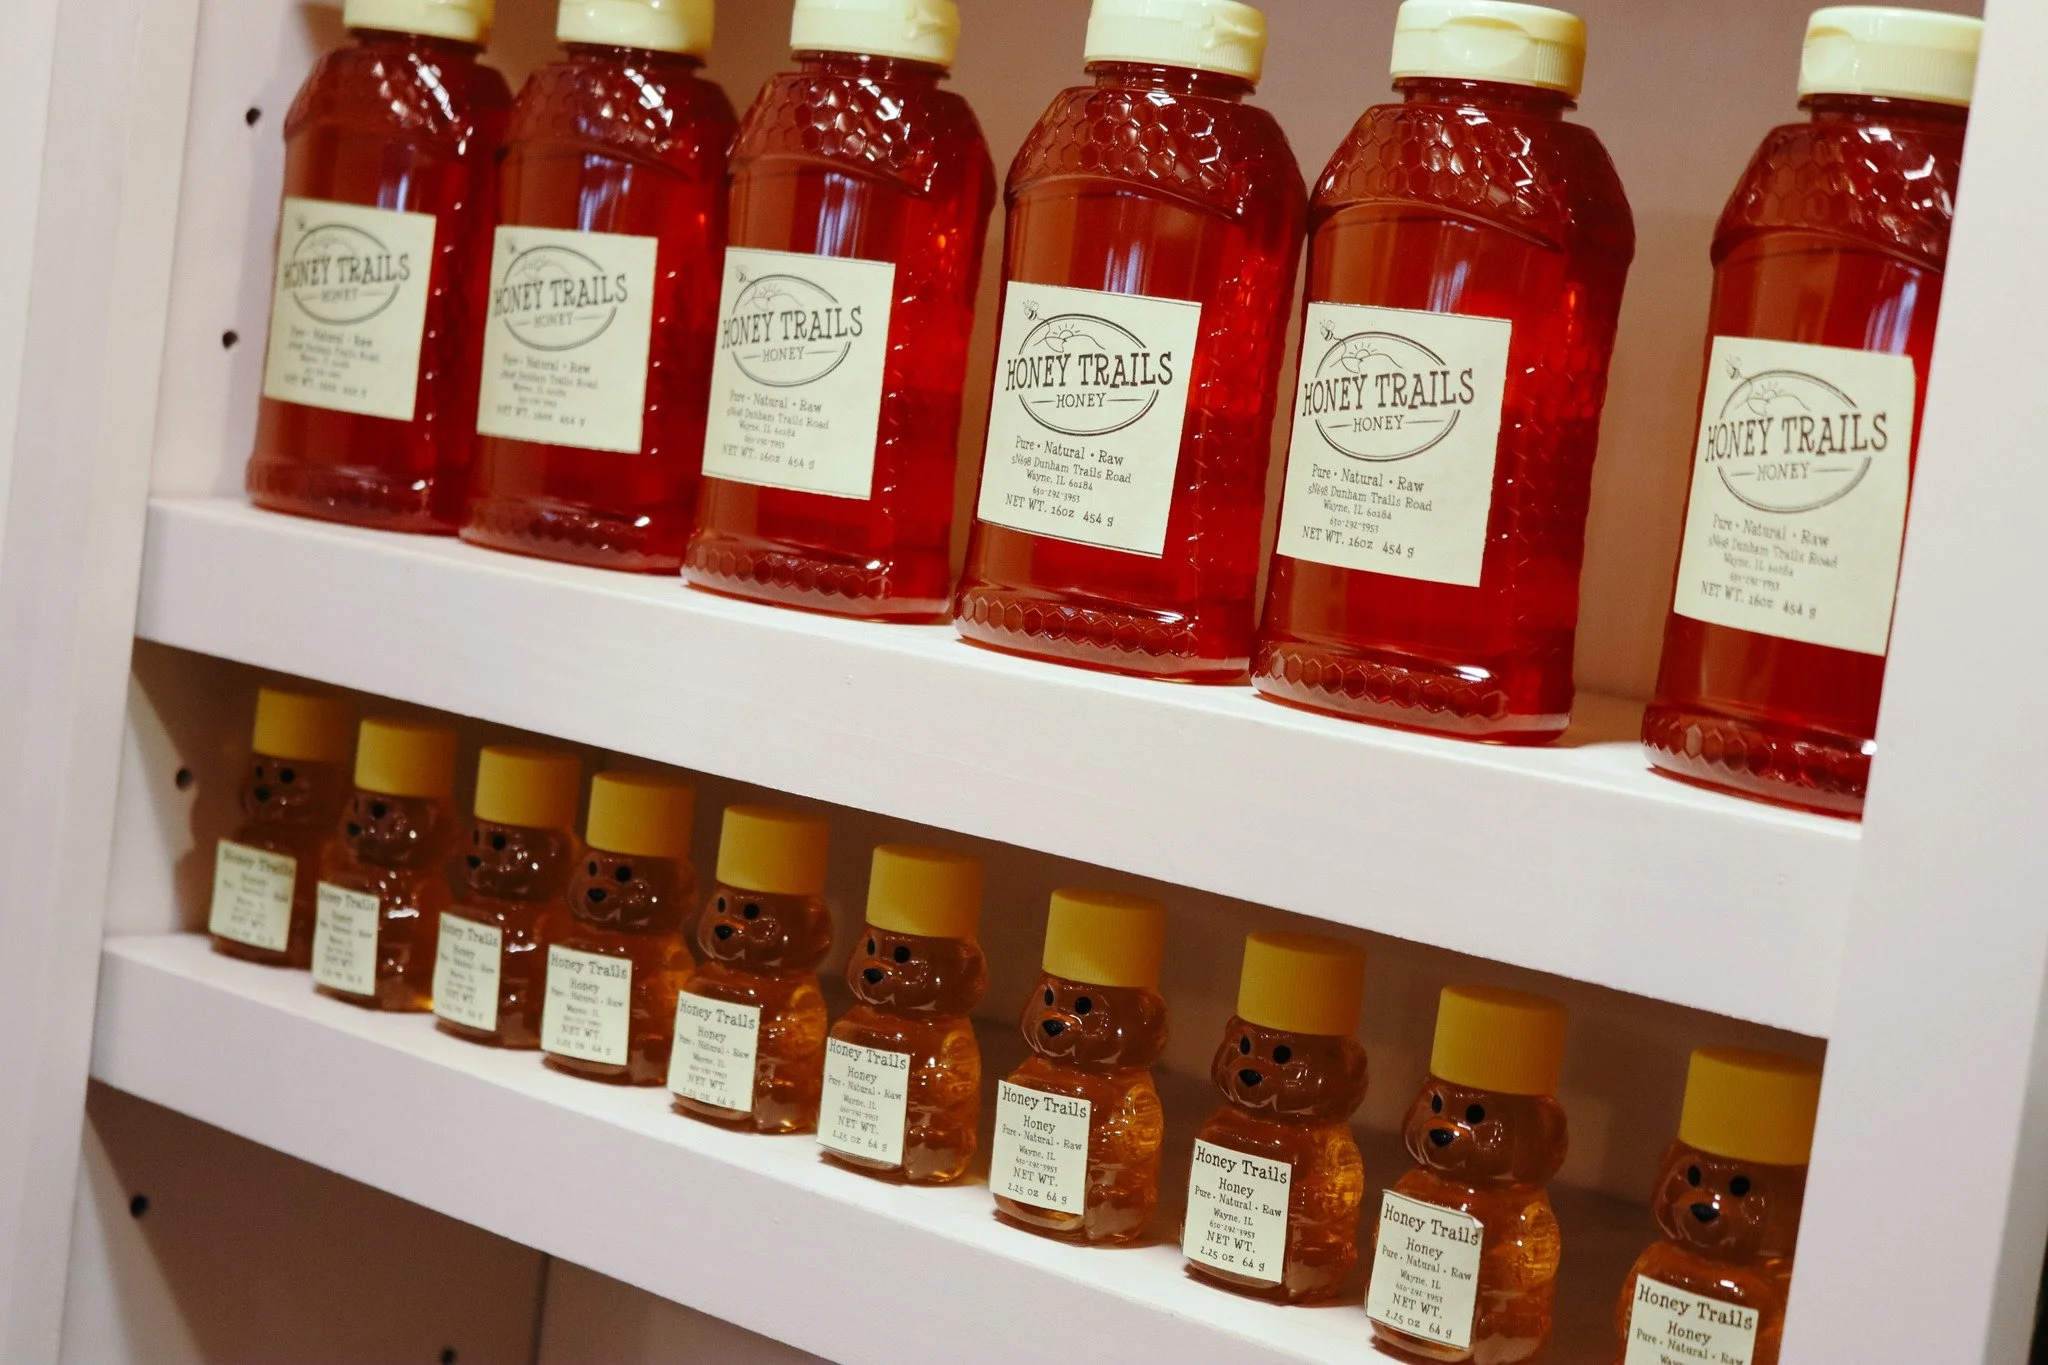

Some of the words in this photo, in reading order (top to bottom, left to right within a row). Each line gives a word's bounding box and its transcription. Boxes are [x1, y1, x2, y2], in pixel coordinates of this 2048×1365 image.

[284, 256, 331, 288] HONEY
[338, 253, 411, 285] TRAILS
[494, 280, 543, 316] HONEY
[551, 274, 628, 308] TRAILS
[534, 312, 574, 328] HONEY
[722, 311, 774, 349] HONEY
[781, 306, 862, 341] TRAILS
[763, 346, 805, 362] HONEY
[1005, 353, 1071, 391] HONEY
[1078, 351, 1173, 388] TRAILS
[730, 389, 745, 402] Pure
[754, 393, 787, 408] Natural
[800, 399, 822, 412] Raw
[1056, 393, 1106, 408] HONEY
[1302, 374, 1368, 417] HONEY
[1375, 368, 1475, 410] TRAILS
[745, 408, 774, 422] Dunham
[778, 413, 802, 426] Trails
[807, 418, 829, 429] Road
[1353, 414, 1404, 433] HONEY
[1705, 416, 1774, 463] HONEY
[1782, 412, 1888, 457] TRAILS
[722, 444, 738, 456] NET
[788, 456, 804, 468] 454
[809, 460, 815, 470] g
[1016, 435, 1034, 450] Pure
[1044, 441, 1085, 459] Natural
[1098, 450, 1124, 466] Raw
[1027, 469, 1053, 484] Wayne,
[1056, 475, 1065, 485] IL
[1069, 478, 1093, 491] 60184
[1034, 457, 1069, 473] Dunham
[1073, 463, 1102, 478] Trails
[1106, 470, 1132, 484] Road
[1312, 463, 1331, 479] Pure
[1341, 468, 1383, 487] Natural
[1397, 476, 1425, 492] Raw
[1757, 462, 1809, 481] HONEY
[1005, 493, 1025, 507] NET
[1029, 498, 1047, 513] WT.
[1051, 505, 1075, 518] 16oz
[1083, 511, 1102, 524] 454
[1107, 516, 1114, 527] g
[1324, 499, 1350, 514] Wayne,
[1354, 505, 1363, 515] IL
[1366, 508, 1392, 520] 60184
[1331, 486, 1366, 502] Dunham
[1371, 492, 1401, 507] Trails
[1406, 497, 1433, 511] Road
[1302, 526, 1322, 540] NET
[1326, 529, 1344, 545] WT.
[1349, 536, 1374, 549] 16oz
[1382, 541, 1401, 555] 454
[1407, 546, 1415, 558] g
[1713, 512, 1732, 531] Pure
[1743, 518, 1786, 540] Natural
[1801, 529, 1829, 547] Raw
[1774, 546, 1804, 563] Trails
[1809, 551, 1838, 568] Road
[1701, 581, 1721, 597] NET
[1725, 585, 1744, 603] WT.
[1783, 601, 1803, 616] 454
[1809, 607, 1817, 620] g
[551, 953, 583, 973] Honey
[589, 961, 627, 979] Trails
[571, 978, 599, 993] Honey
[680, 999, 712, 1021] Honey
[716, 1009, 755, 1029] Trails
[697, 1026, 726, 1043] Honey
[698, 1040, 725, 1054] Natural
[733, 1048, 749, 1059] Raw
[829, 1041, 862, 1061] Honey
[867, 1049, 907, 1070] Trails
[688, 1074, 706, 1086] NET
[710, 1080, 728, 1092] WT.
[828, 1075, 841, 1086] Pure
[848, 1081, 876, 1095] Natural
[884, 1089, 902, 1100] Raw
[847, 1066, 878, 1084] Honey
[869, 1101, 877, 1109] IL
[1003, 1086, 1039, 1110] Honey
[1044, 1097, 1086, 1118] Trails
[838, 1116, 857, 1129] NET
[861, 1122, 879, 1135] WT.
[1003, 1124, 1016, 1136] Pure
[1024, 1131, 1054, 1145] Natural
[1064, 1139, 1082, 1150] Raw
[1023, 1115, 1056, 1134] Honey
[851, 1136, 861, 1144] oz
[868, 1139, 878, 1149] 64
[882, 1144, 888, 1152] g
[1019, 1145, 1043, 1159] Wayne,
[1047, 1152, 1055, 1160] IL
[1013, 1167, 1034, 1181] NET
[1038, 1173, 1058, 1187] WT.
[1196, 1146, 1237, 1172] Honey
[1242, 1160, 1287, 1184] Trails
[1008, 1183, 1023, 1195] 2.25
[1028, 1189, 1039, 1197] oz
[1047, 1191, 1057, 1202] 64
[1062, 1196, 1067, 1205] g
[1219, 1177, 1254, 1198] Honey
[1195, 1185, 1211, 1199] Pure
[1219, 1193, 1252, 1210] Natural
[1262, 1204, 1281, 1217] Raw
[1214, 1208, 1240, 1224] Wayne,
[1244, 1216, 1253, 1225] IL
[1384, 1203, 1426, 1232] Honey
[1431, 1219, 1479, 1246] Trails
[1207, 1230, 1230, 1246] NET
[1234, 1238, 1255, 1253] WT.
[1406, 1237, 1443, 1260] Honey
[1200, 1246, 1218, 1260] 2.25
[1222, 1253, 1234, 1263] oz
[1242, 1257, 1254, 1268] 64
[1259, 1262, 1265, 1272] g
[1382, 1245, 1398, 1260] Pure
[1407, 1254, 1440, 1273] Natural
[1451, 1267, 1472, 1281] Raw
[1401, 1269, 1427, 1286] Wayne,
[1432, 1280, 1441, 1289] IL
[1392, 1293, 1416, 1310] NET
[1421, 1302, 1442, 1318] WT.
[1638, 1284, 1690, 1316] Honey
[1697, 1301, 1752, 1331] Trails
[1386, 1309, 1403, 1324] 2.25
[1408, 1318, 1420, 1328] oz
[1429, 1322, 1440, 1334] 64
[1446, 1329, 1452, 1339] g
[1668, 1321, 1712, 1346] Honey
[1637, 1329, 1657, 1344] Pure
[1668, 1340, 1708, 1359] Natural
